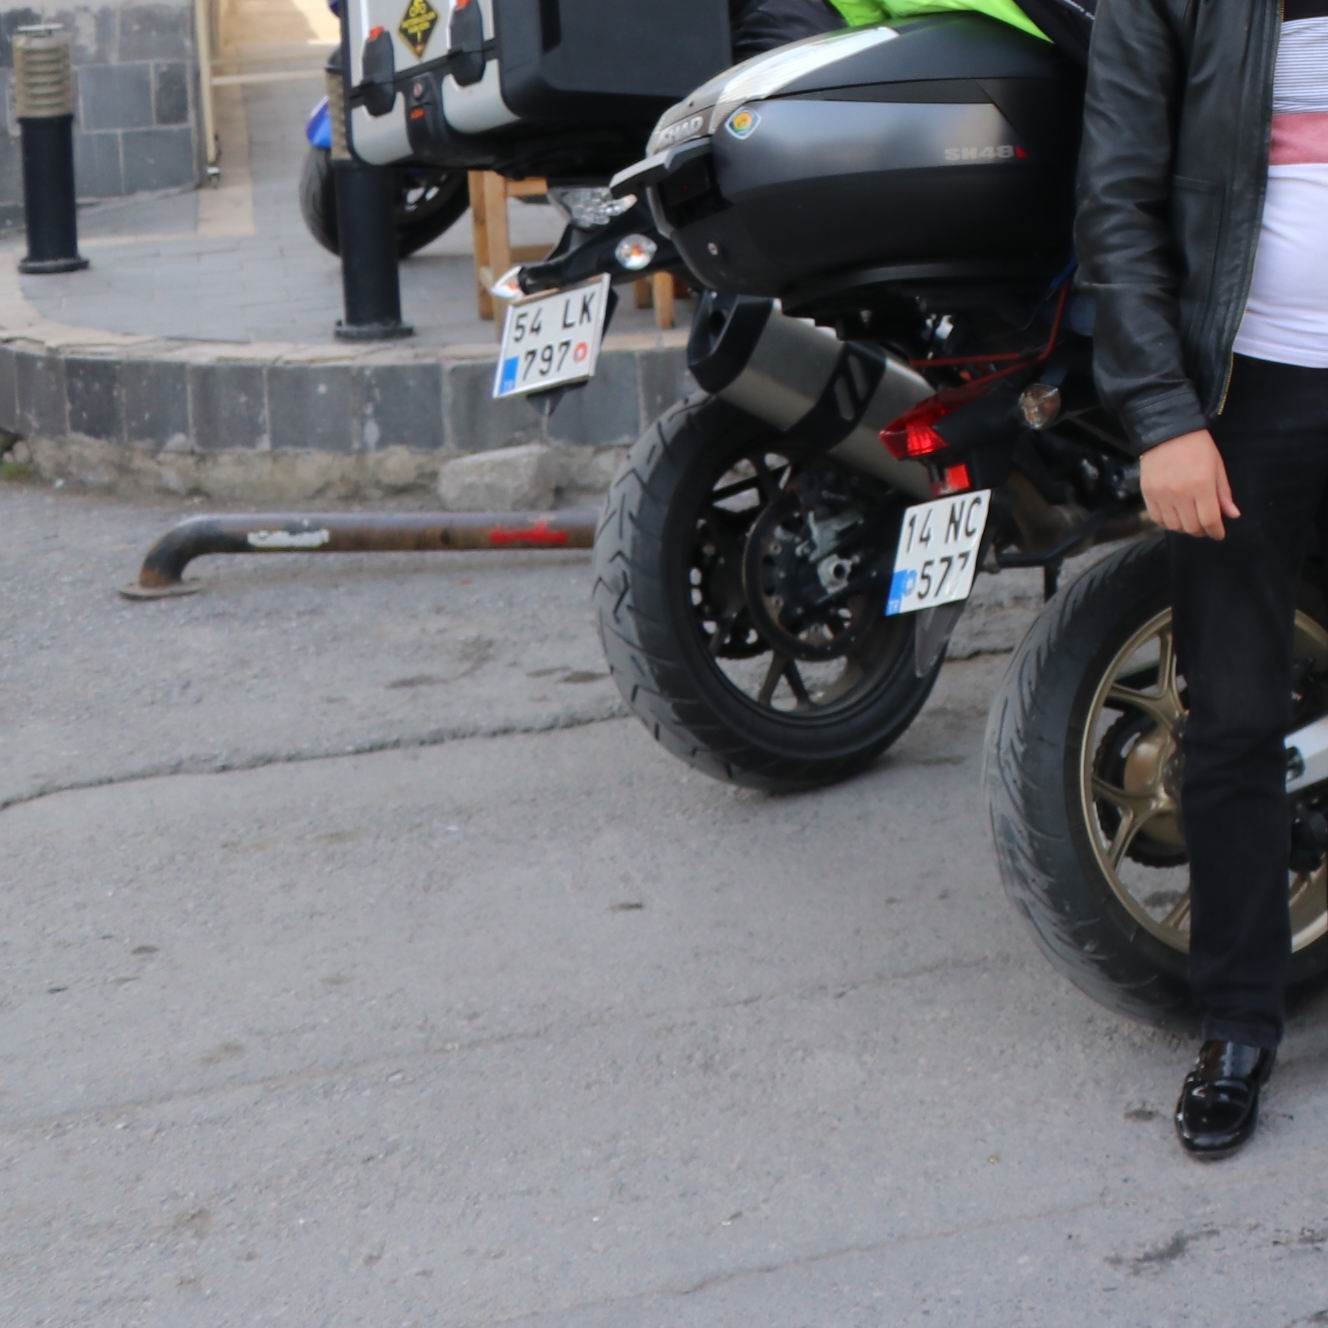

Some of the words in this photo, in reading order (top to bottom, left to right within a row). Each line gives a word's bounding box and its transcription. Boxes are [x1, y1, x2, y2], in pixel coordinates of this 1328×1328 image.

[513, 307, 543, 343] 54
[561, 290, 596, 330] LK
[522, 339, 573, 382] 797
[906, 508, 933, 555] 14
[944, 496, 982, 545] NC
